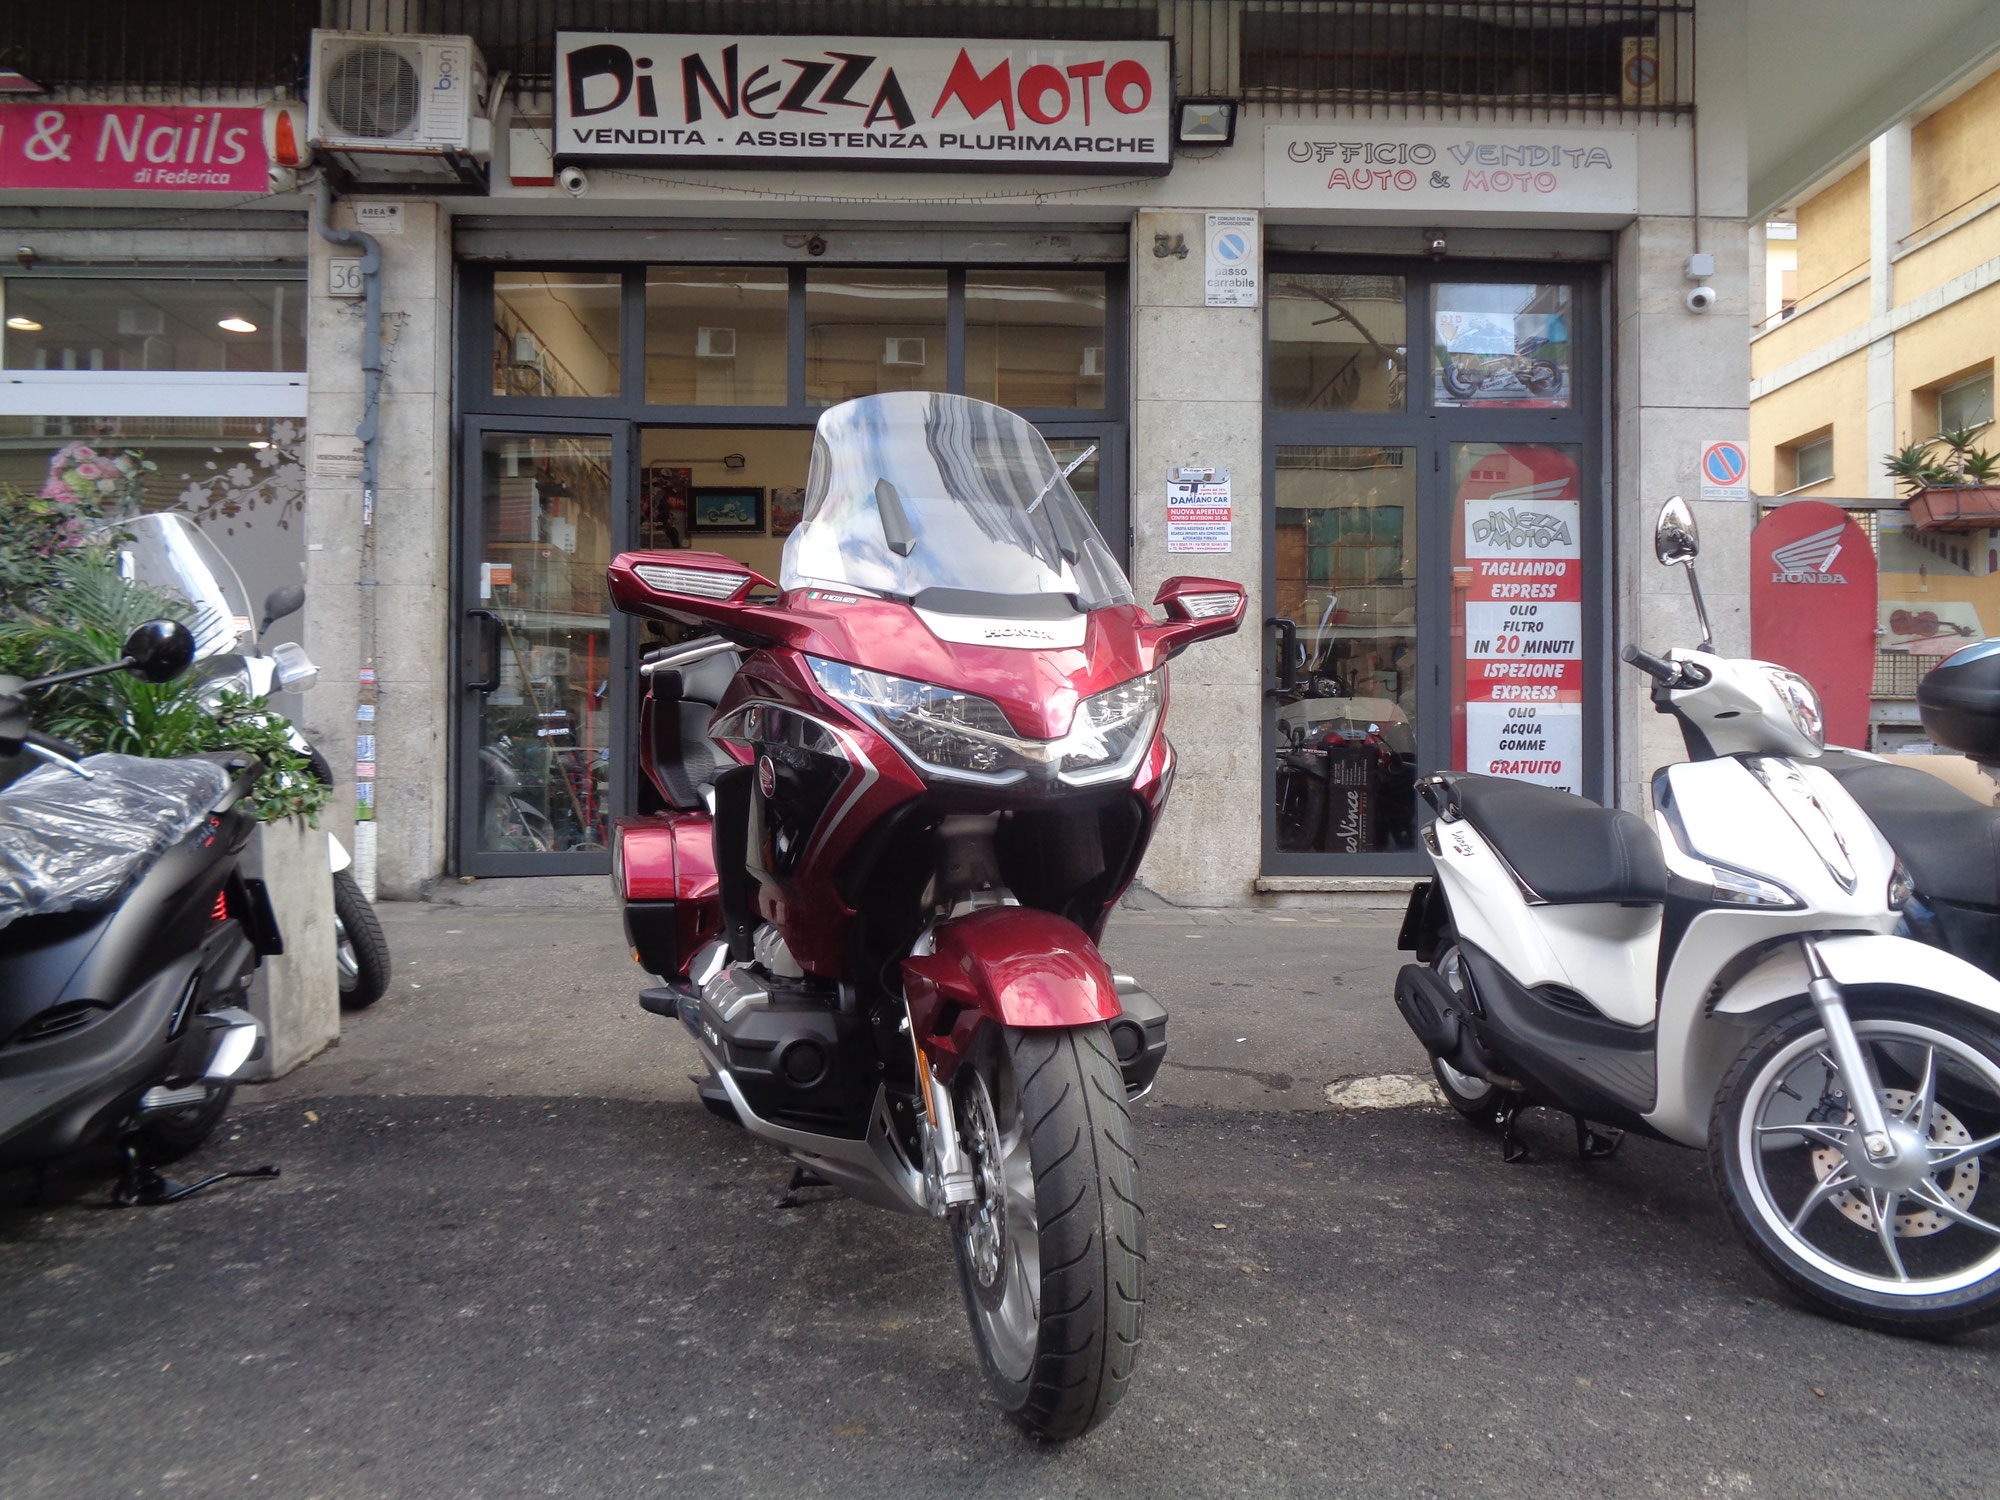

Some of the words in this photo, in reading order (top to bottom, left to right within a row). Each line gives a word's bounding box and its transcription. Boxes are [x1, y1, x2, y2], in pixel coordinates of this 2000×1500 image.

[566, 44, 658, 118] Di
[931, 46, 1152, 132] MOTO
[24, 110, 71, 162] &
[96, 112, 249, 165] Nails
[573, 128, 706, 146] VENDITA
[735, 130, 928, 149] ASSISTENZA
[939, 133, 1155, 153] PLURIMARCHE
[1287, 140, 1437, 166] UFFICIO
[1448, 141, 1613, 170] VENDITA
[134, 168, 151, 184] di
[155, 169, 231, 185] Federica
[1327, 168, 1417, 192] AUTO
[1429, 171, 1451, 189] &
[1463, 170, 1557, 194] MOTO
[362, 208, 385, 216] AREA
[332, 265, 360, 289] 36
[1215, 268, 1248, 277] passo
[1207, 278, 1255, 287] carrabile
[1170, 496, 1212, 505] DAMIANO
[1488, 528, 1551, 550] MOTO
[1481, 561, 1567, 577] TAGLIANDO
[1771, 572, 1848, 584] HONDA
[1491, 583, 1558, 599] EXPRESS
[1509, 605, 1537, 616] OLIO
[1503, 621, 1544, 632] FILTRO
[984, 629, 1056, 640] HONDA
[1474, 640, 1490, 653] IN
[1495, 635, 1521, 654] 20
[1523, 640, 1575, 654] MINUTI
[1483, 663, 1565, 678] ISPEZIONE
[1491, 685, 1558, 700] EXPRESS
[1508, 707, 1536, 719] OLIO
[1502, 723, 1542, 735] ACQUA
[1499, 740, 1546, 751] GOMME
[1489, 760, 1562, 775] GRATUITO
[1336, 790, 1358, 853] eoVince
